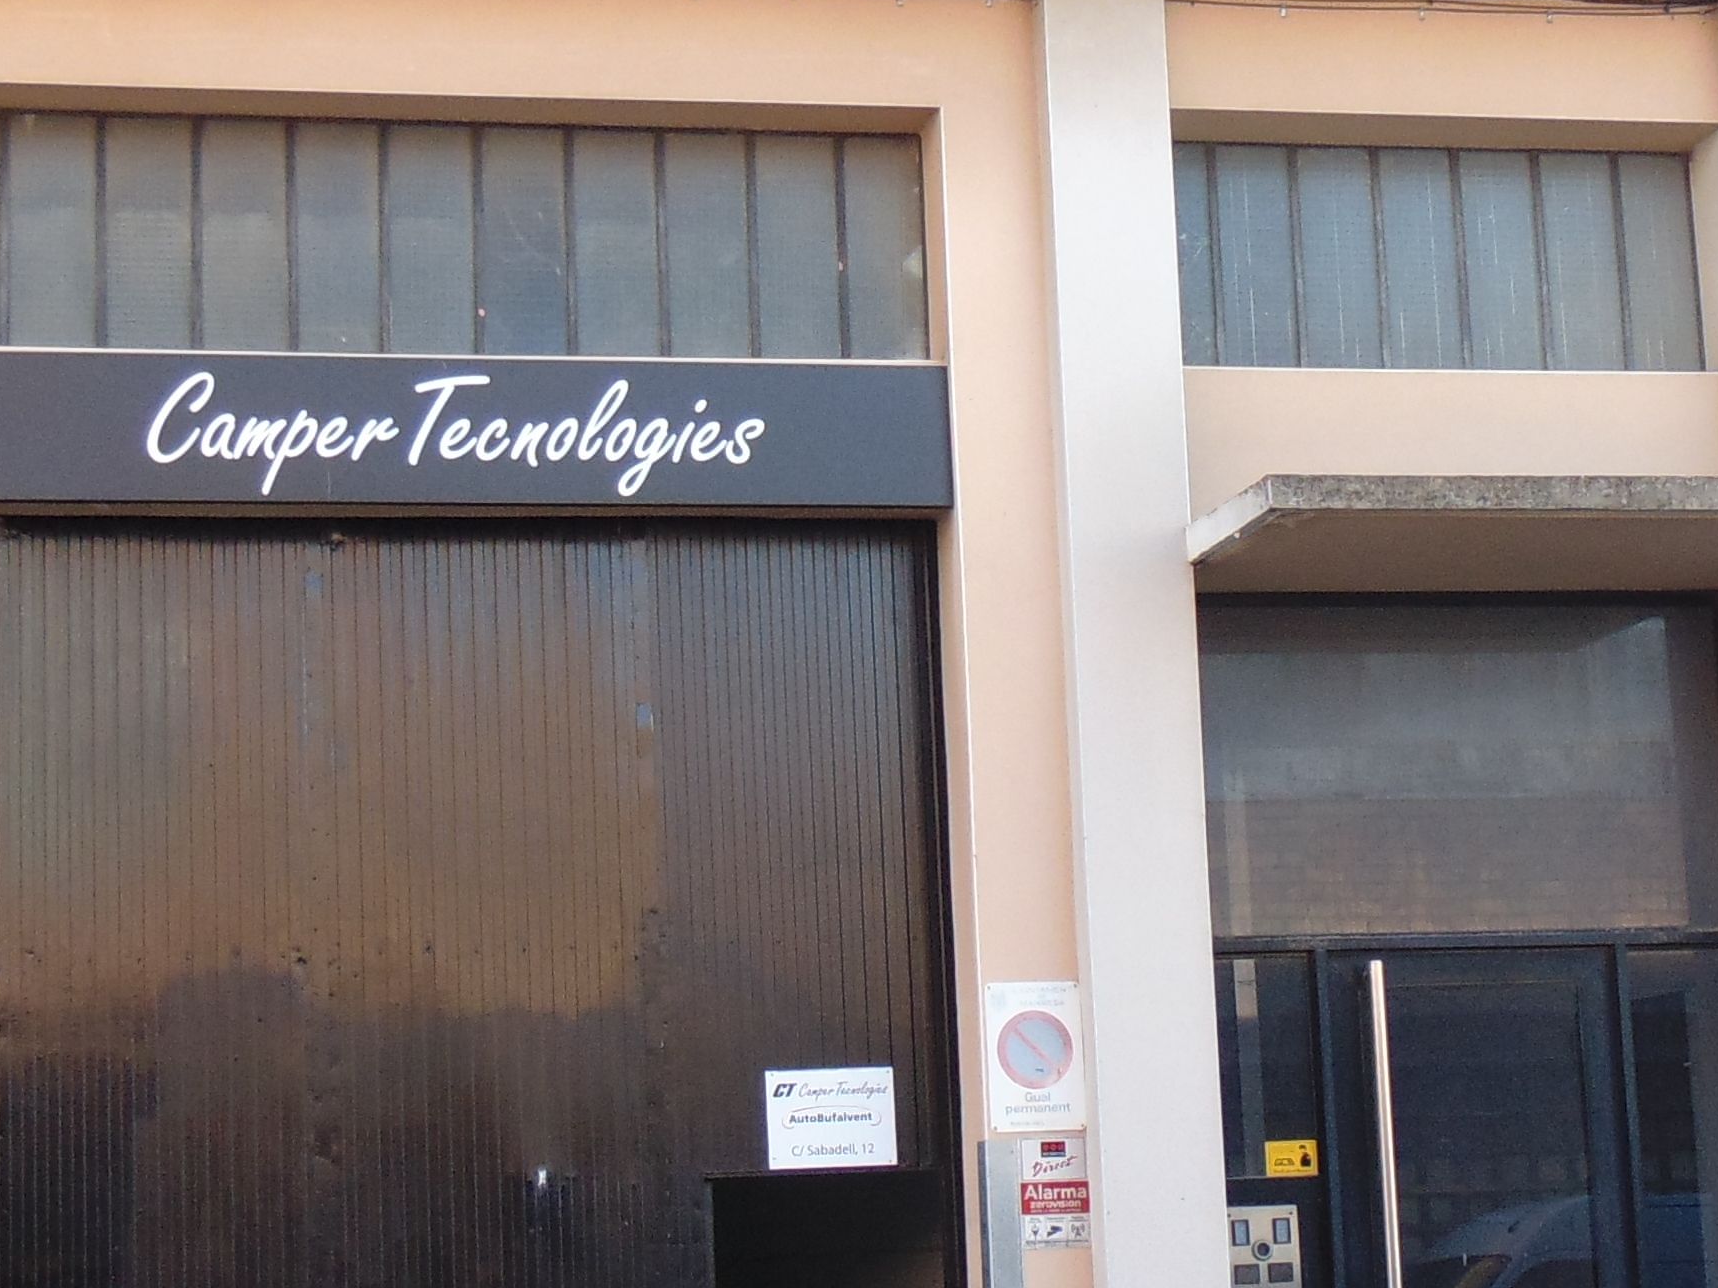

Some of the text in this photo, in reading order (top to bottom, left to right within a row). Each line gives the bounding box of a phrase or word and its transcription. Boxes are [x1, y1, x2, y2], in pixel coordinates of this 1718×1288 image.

[146, 371, 766, 497] Camper Tecnologies
[773, 1081, 888, 1102] CT Camper Tecnologies
[789, 1111, 873, 1124] AutoBufalvent
[1005, 1102, 1072, 1116] permanent
[791, 1142, 875, 1157] C/ Sabadell, 12
[1031, 1155, 1078, 1177] Direct
[1024, 1184, 1087, 1201] Alarma
